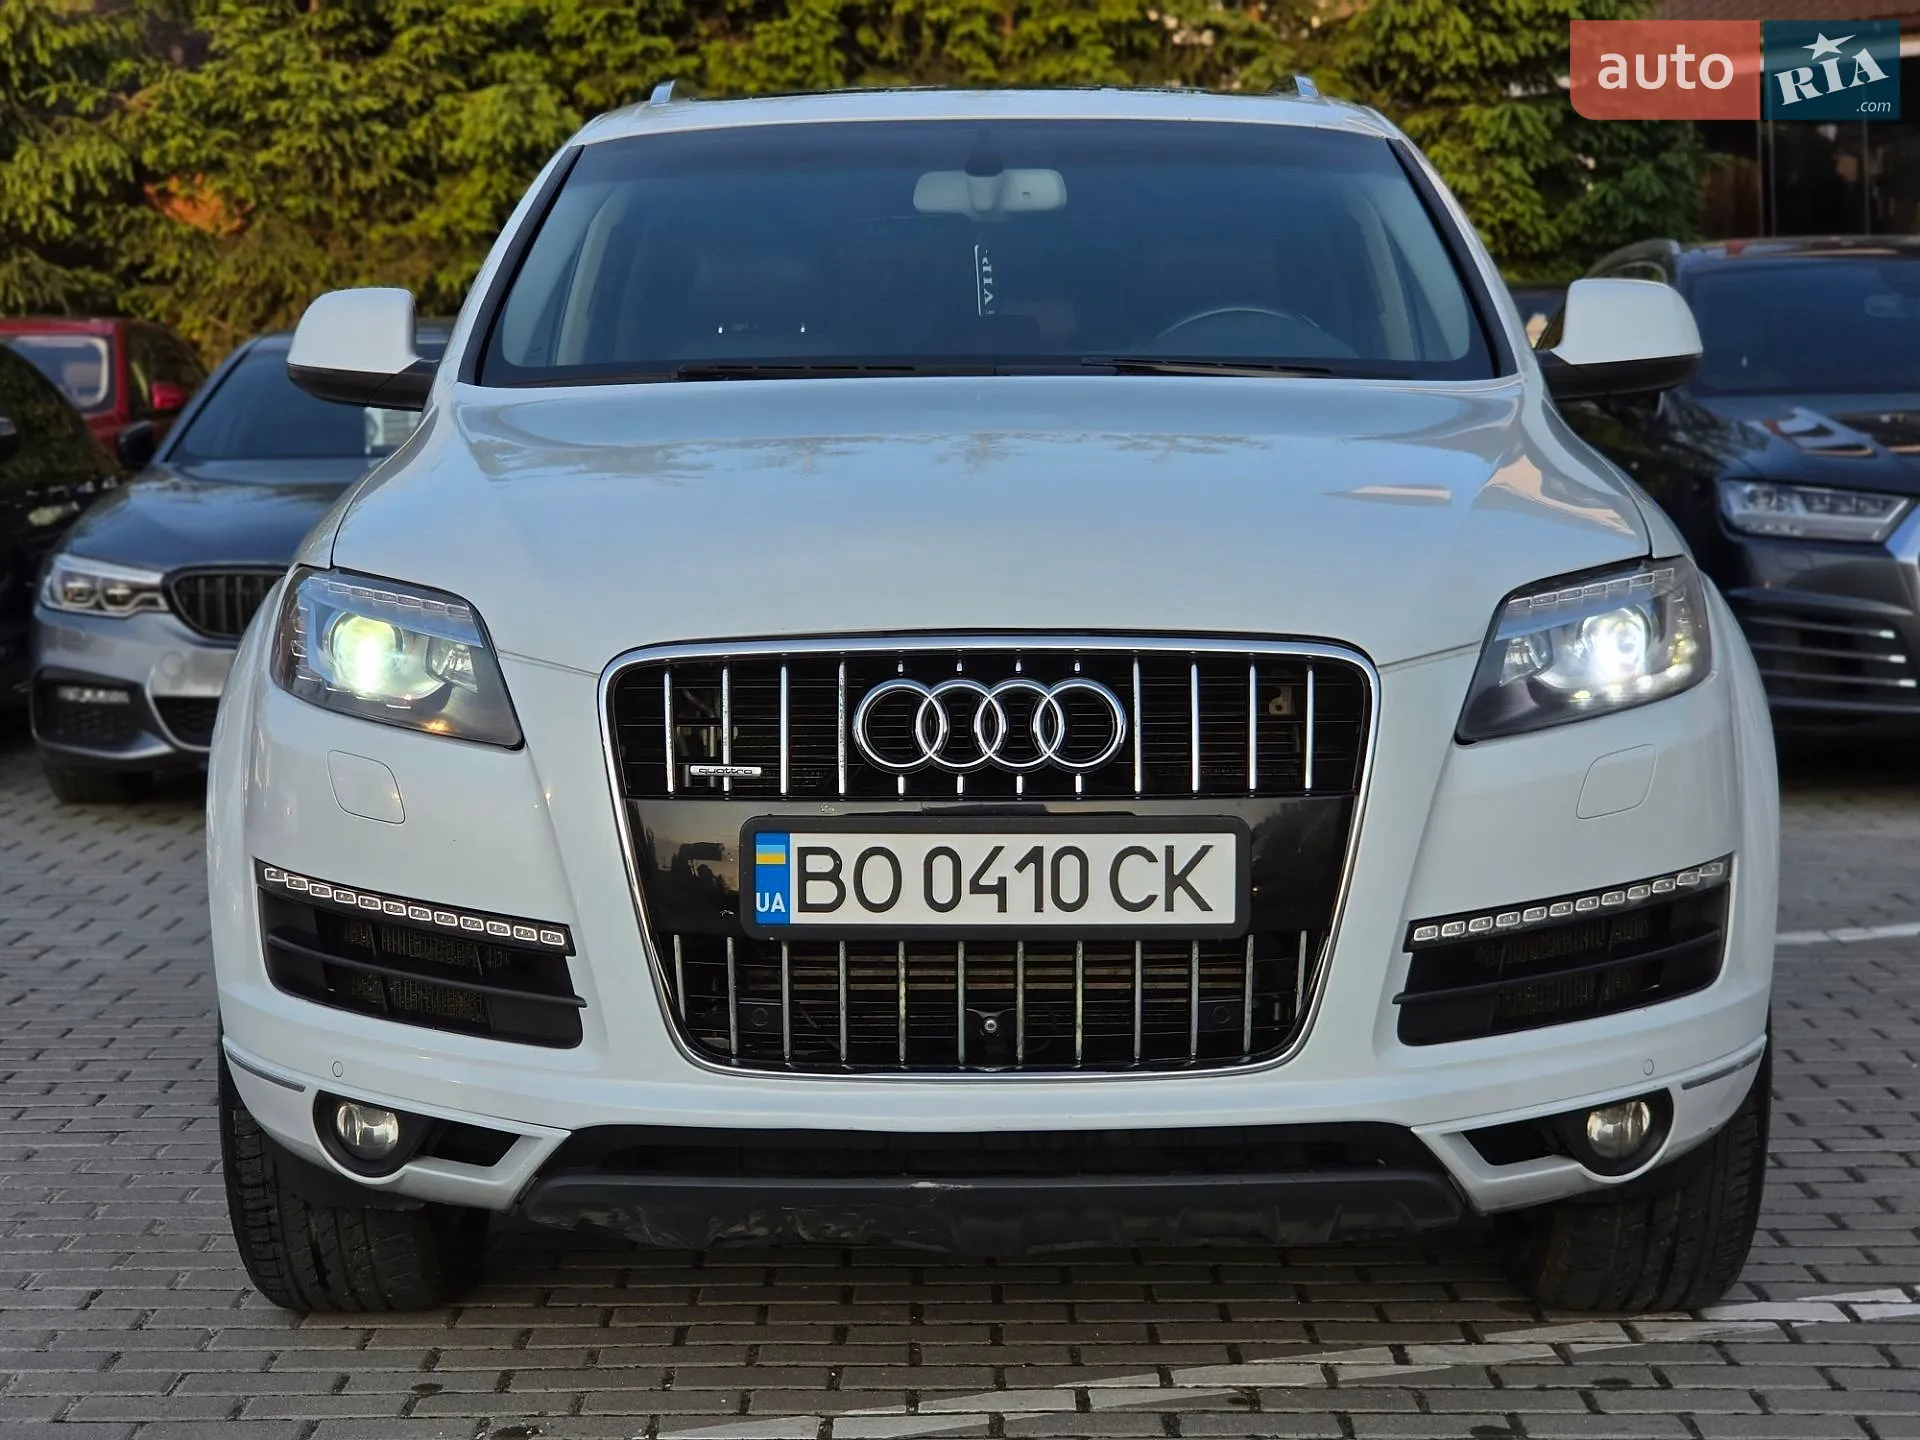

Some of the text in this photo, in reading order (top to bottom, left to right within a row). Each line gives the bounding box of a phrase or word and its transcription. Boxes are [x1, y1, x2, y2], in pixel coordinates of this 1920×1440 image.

[699, 767, 753, 776] quattro
[797, 845, 1214, 913] BO 0410 CK
[756, 892, 786, 913] UA
